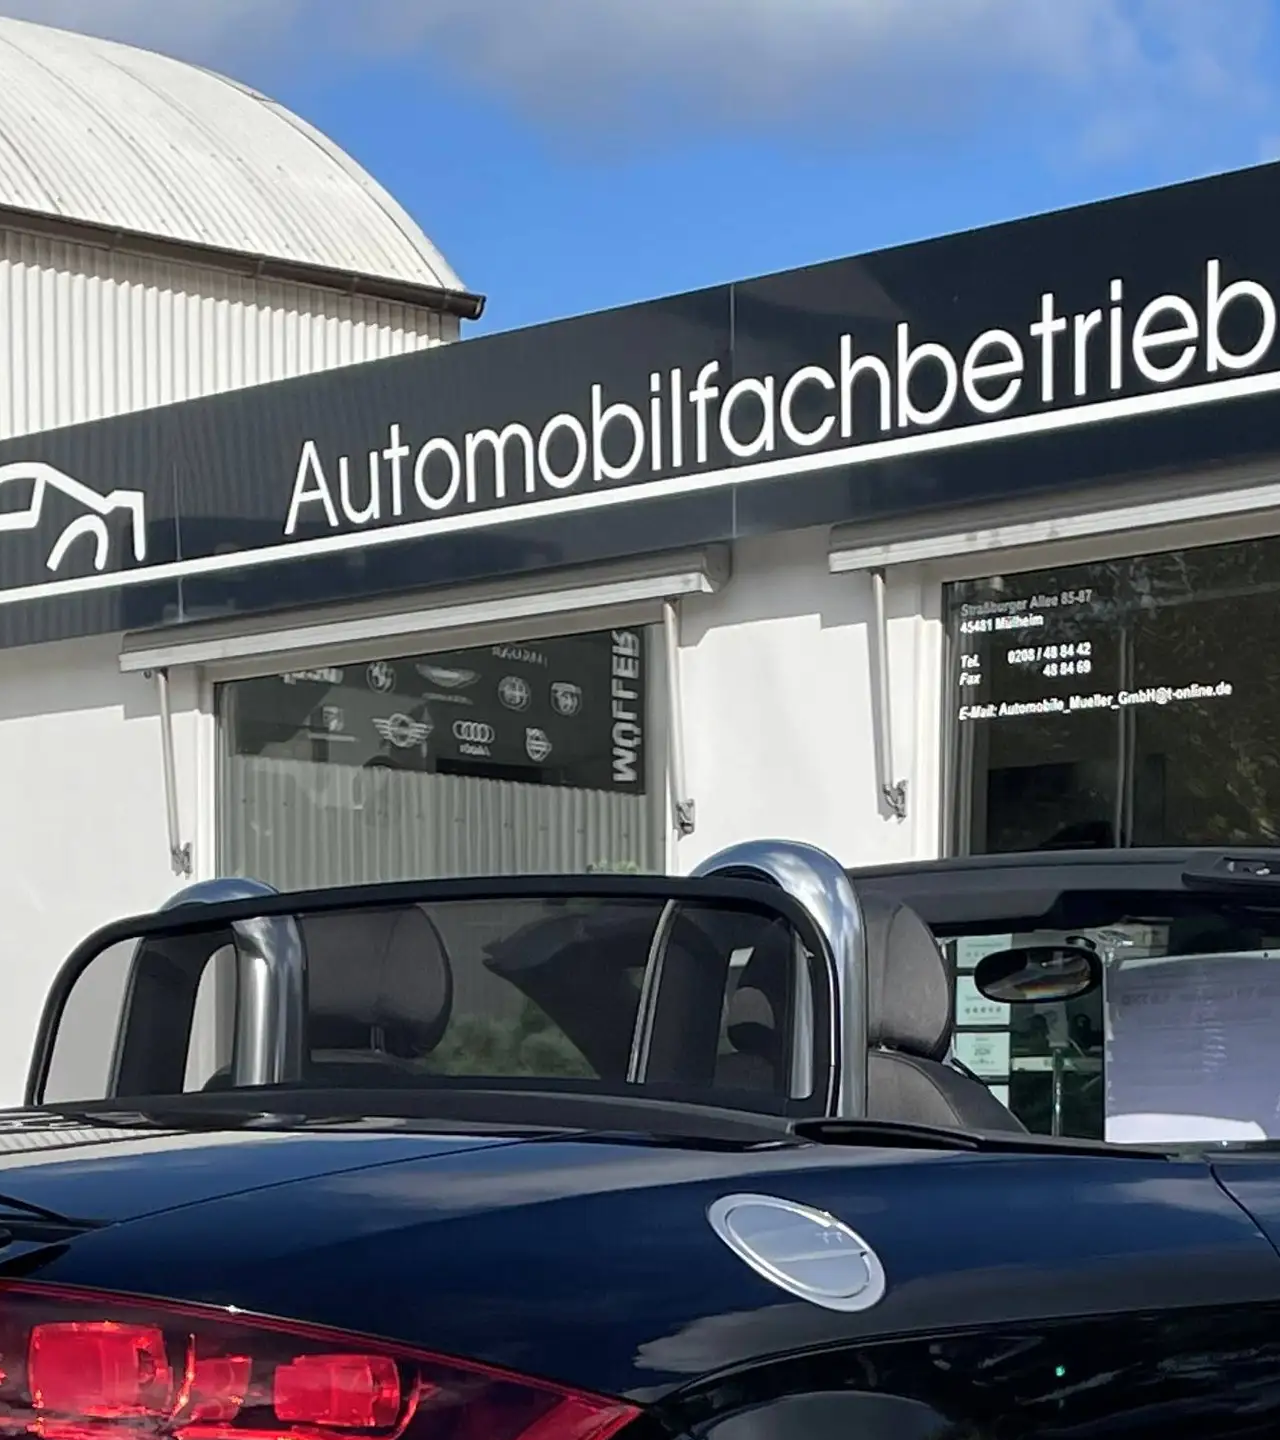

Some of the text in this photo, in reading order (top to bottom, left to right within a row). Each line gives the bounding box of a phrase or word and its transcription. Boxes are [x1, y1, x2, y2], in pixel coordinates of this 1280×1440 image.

[285, 261, 1276, 534] Automobilfachbetrieb
[995, 613, 1044, 630] Mülheim
[1076, 641, 1091, 656] 42
[959, 672, 982, 686] Fax
